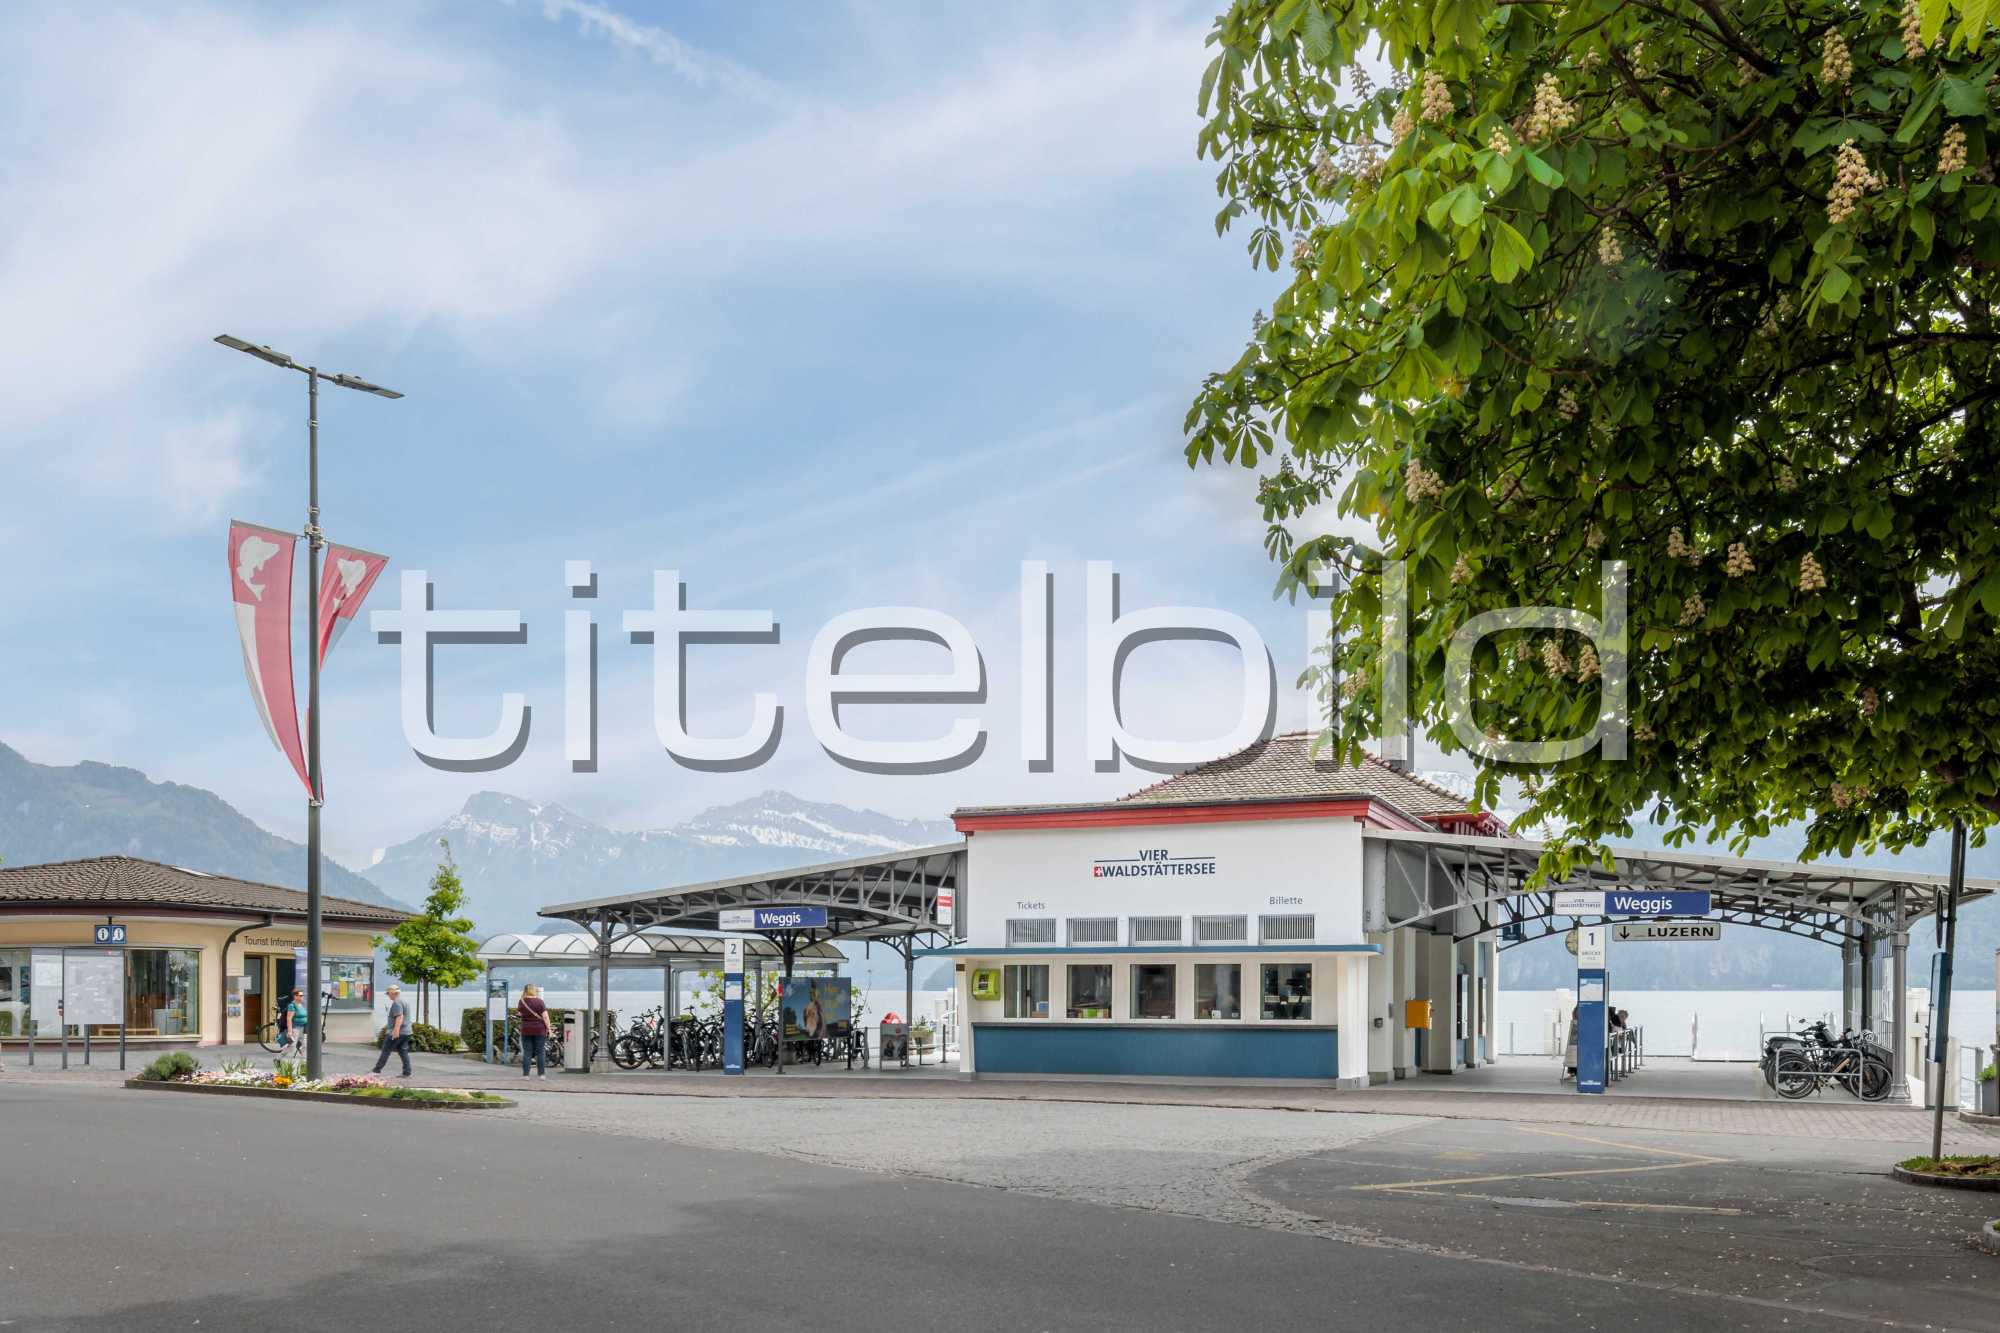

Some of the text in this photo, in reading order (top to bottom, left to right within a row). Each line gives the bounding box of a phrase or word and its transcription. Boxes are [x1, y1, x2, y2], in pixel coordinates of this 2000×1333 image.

[1139, 849, 1169, 861] VIER
[1101, 861, 1216, 877] WALDSTÄTTERSEE
[1016, 901, 1046, 910] Tickets
[1269, 896, 1303, 905] Billette
[1614, 896, 1673, 913] Weggis
[760, 912, 801, 926] Weggis
[1648, 927, 1714, 937] LUZERN
[244, 935, 269, 946] Tourist
[1588, 932, 1595, 946] 1
[730, 943, 737, 954] 2
